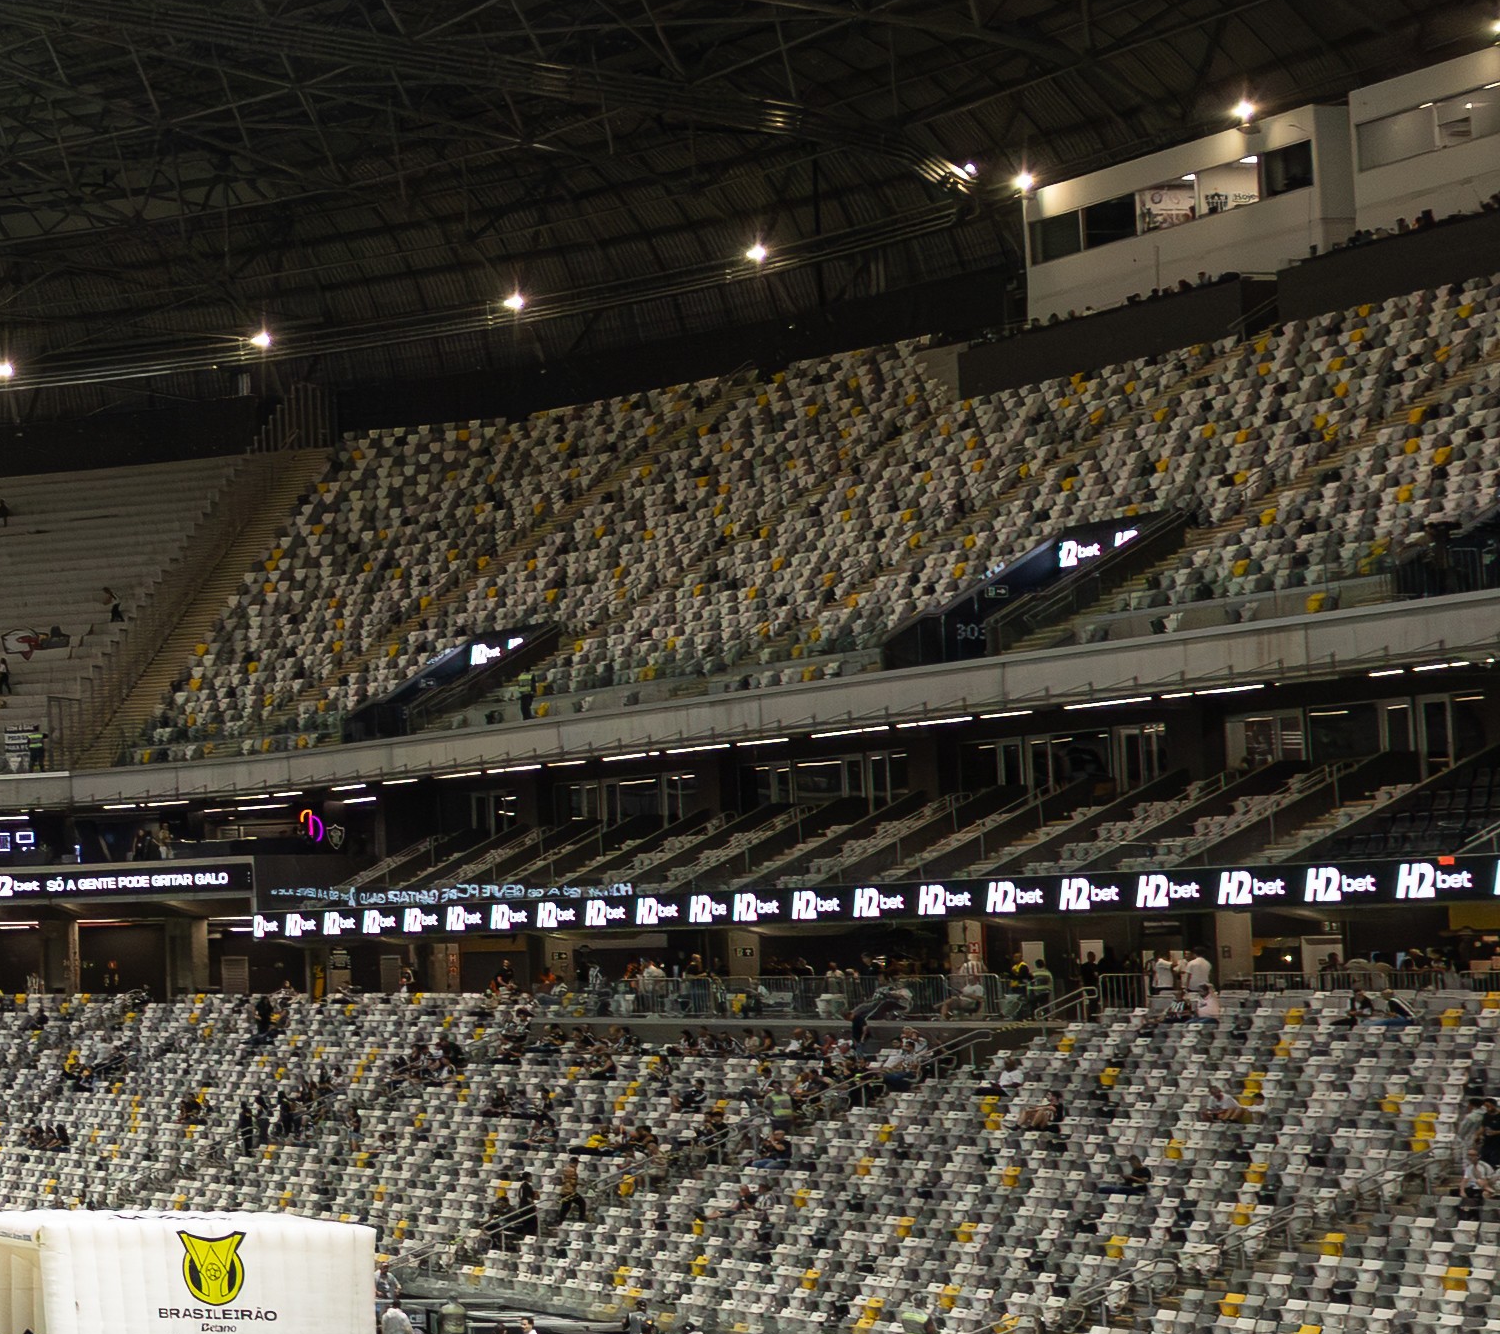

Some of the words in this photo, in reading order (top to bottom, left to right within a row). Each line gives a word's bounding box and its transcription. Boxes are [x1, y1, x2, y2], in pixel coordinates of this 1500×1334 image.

[46, 876, 65, 892] SÓ
[65, 878, 77, 891] A
[78, 877, 117, 891] GENTE
[118, 875, 150, 889] PODE
[151, 874, 193, 888] GRITAR
[194, 872, 229, 886] GALO
[158, 1305, 278, 1323] BRASILEIRÃO
